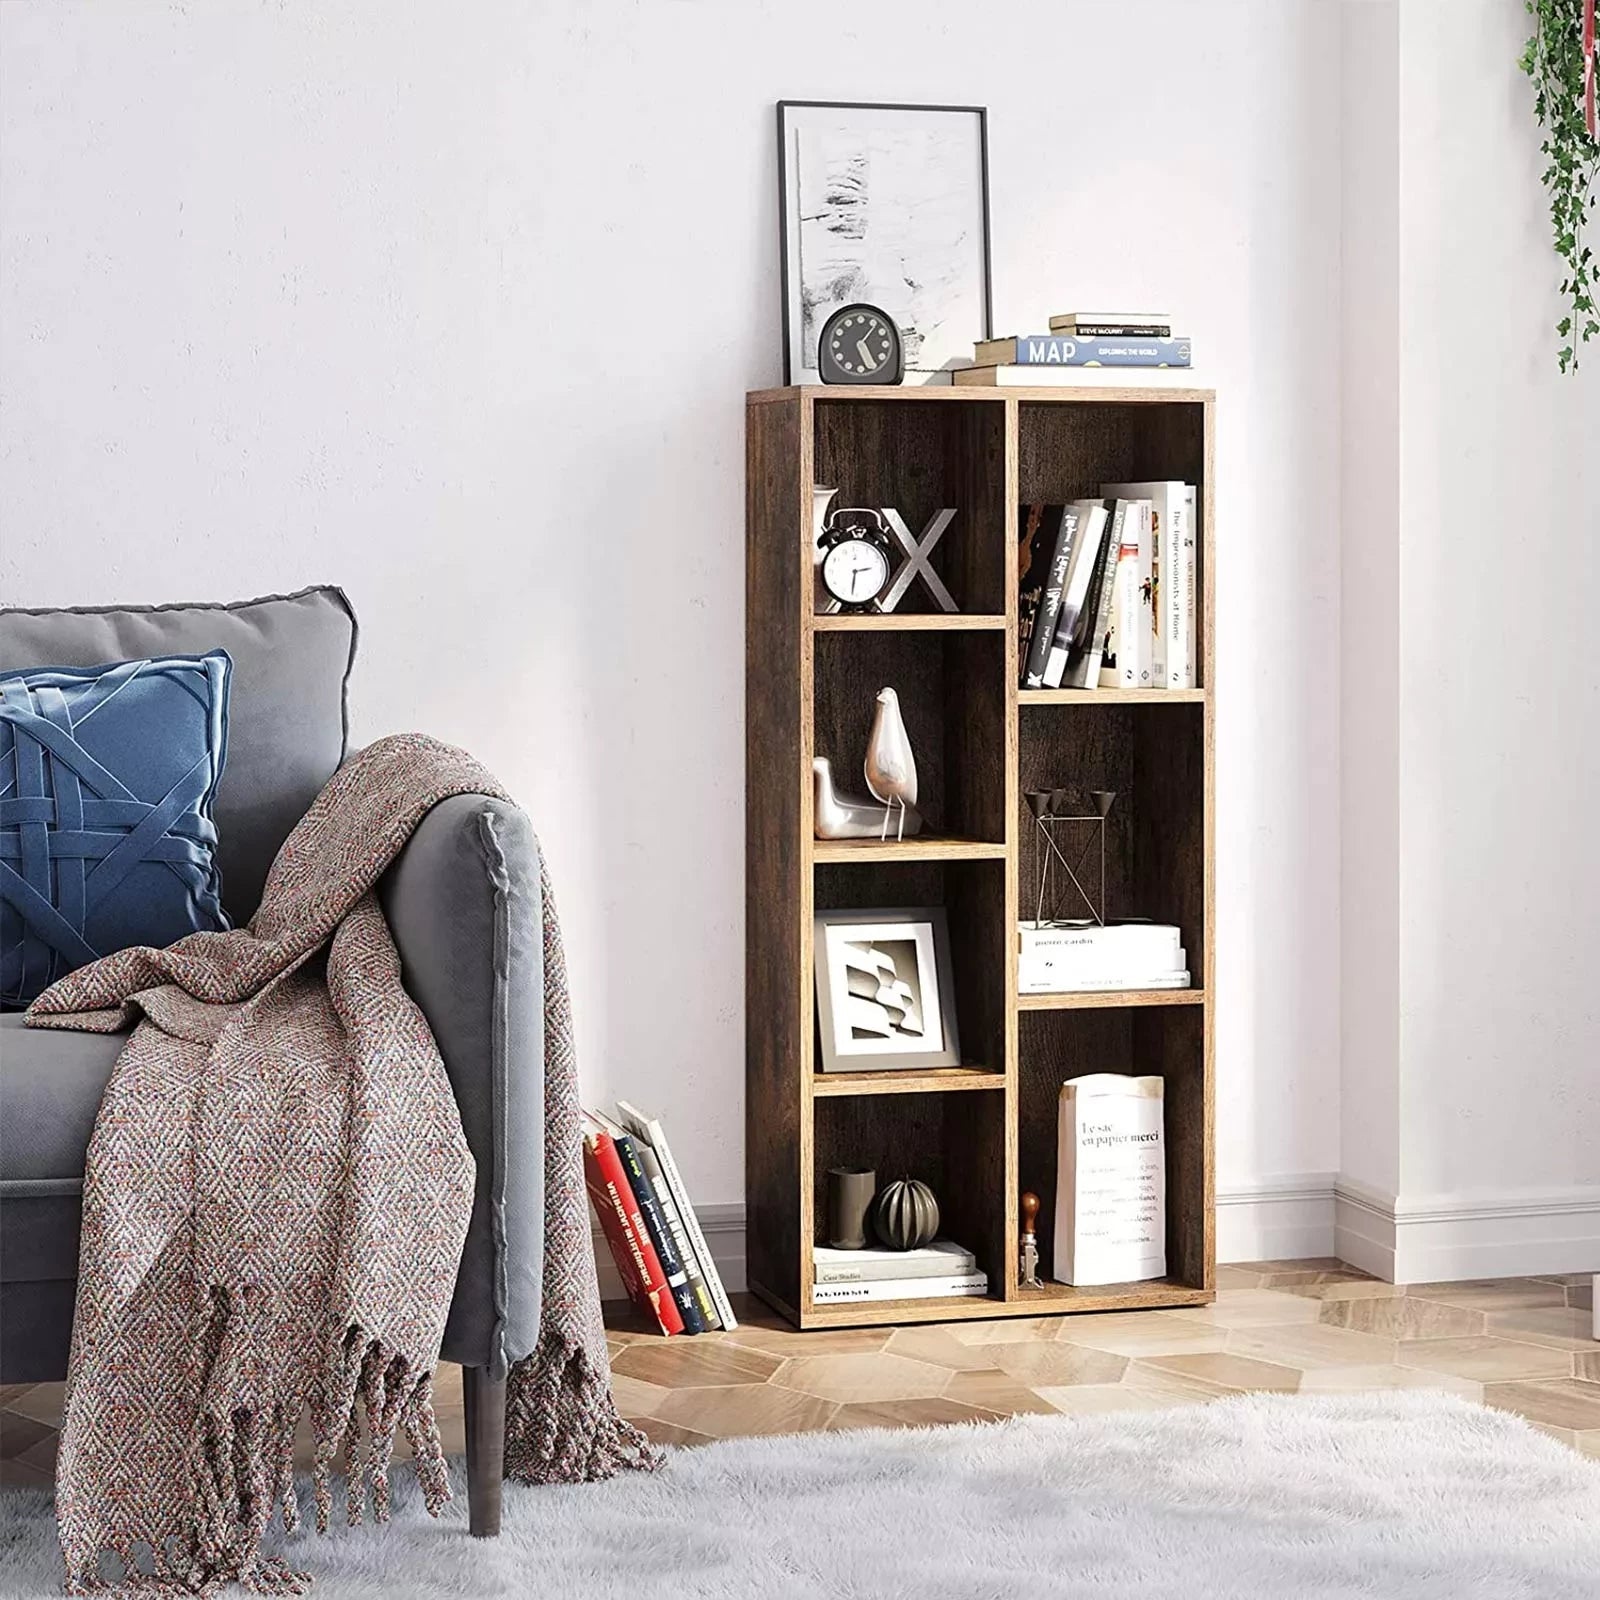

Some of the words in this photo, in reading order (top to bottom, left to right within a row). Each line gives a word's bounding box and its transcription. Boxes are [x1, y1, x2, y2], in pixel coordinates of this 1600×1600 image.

[1029, 341, 1076, 363] MAP
[1128, 348, 1138, 356] THE
[1173, 511, 1181, 527] The
[1172, 530, 1180, 599] Impressionists
[1171, 614, 1180, 641] Home
[1082, 1137, 1094, 1146] en
[1096, 1135, 1128, 1148] papier
[1130, 1130, 1159, 1142] merci
[822, 1274, 838, 1282] Case
